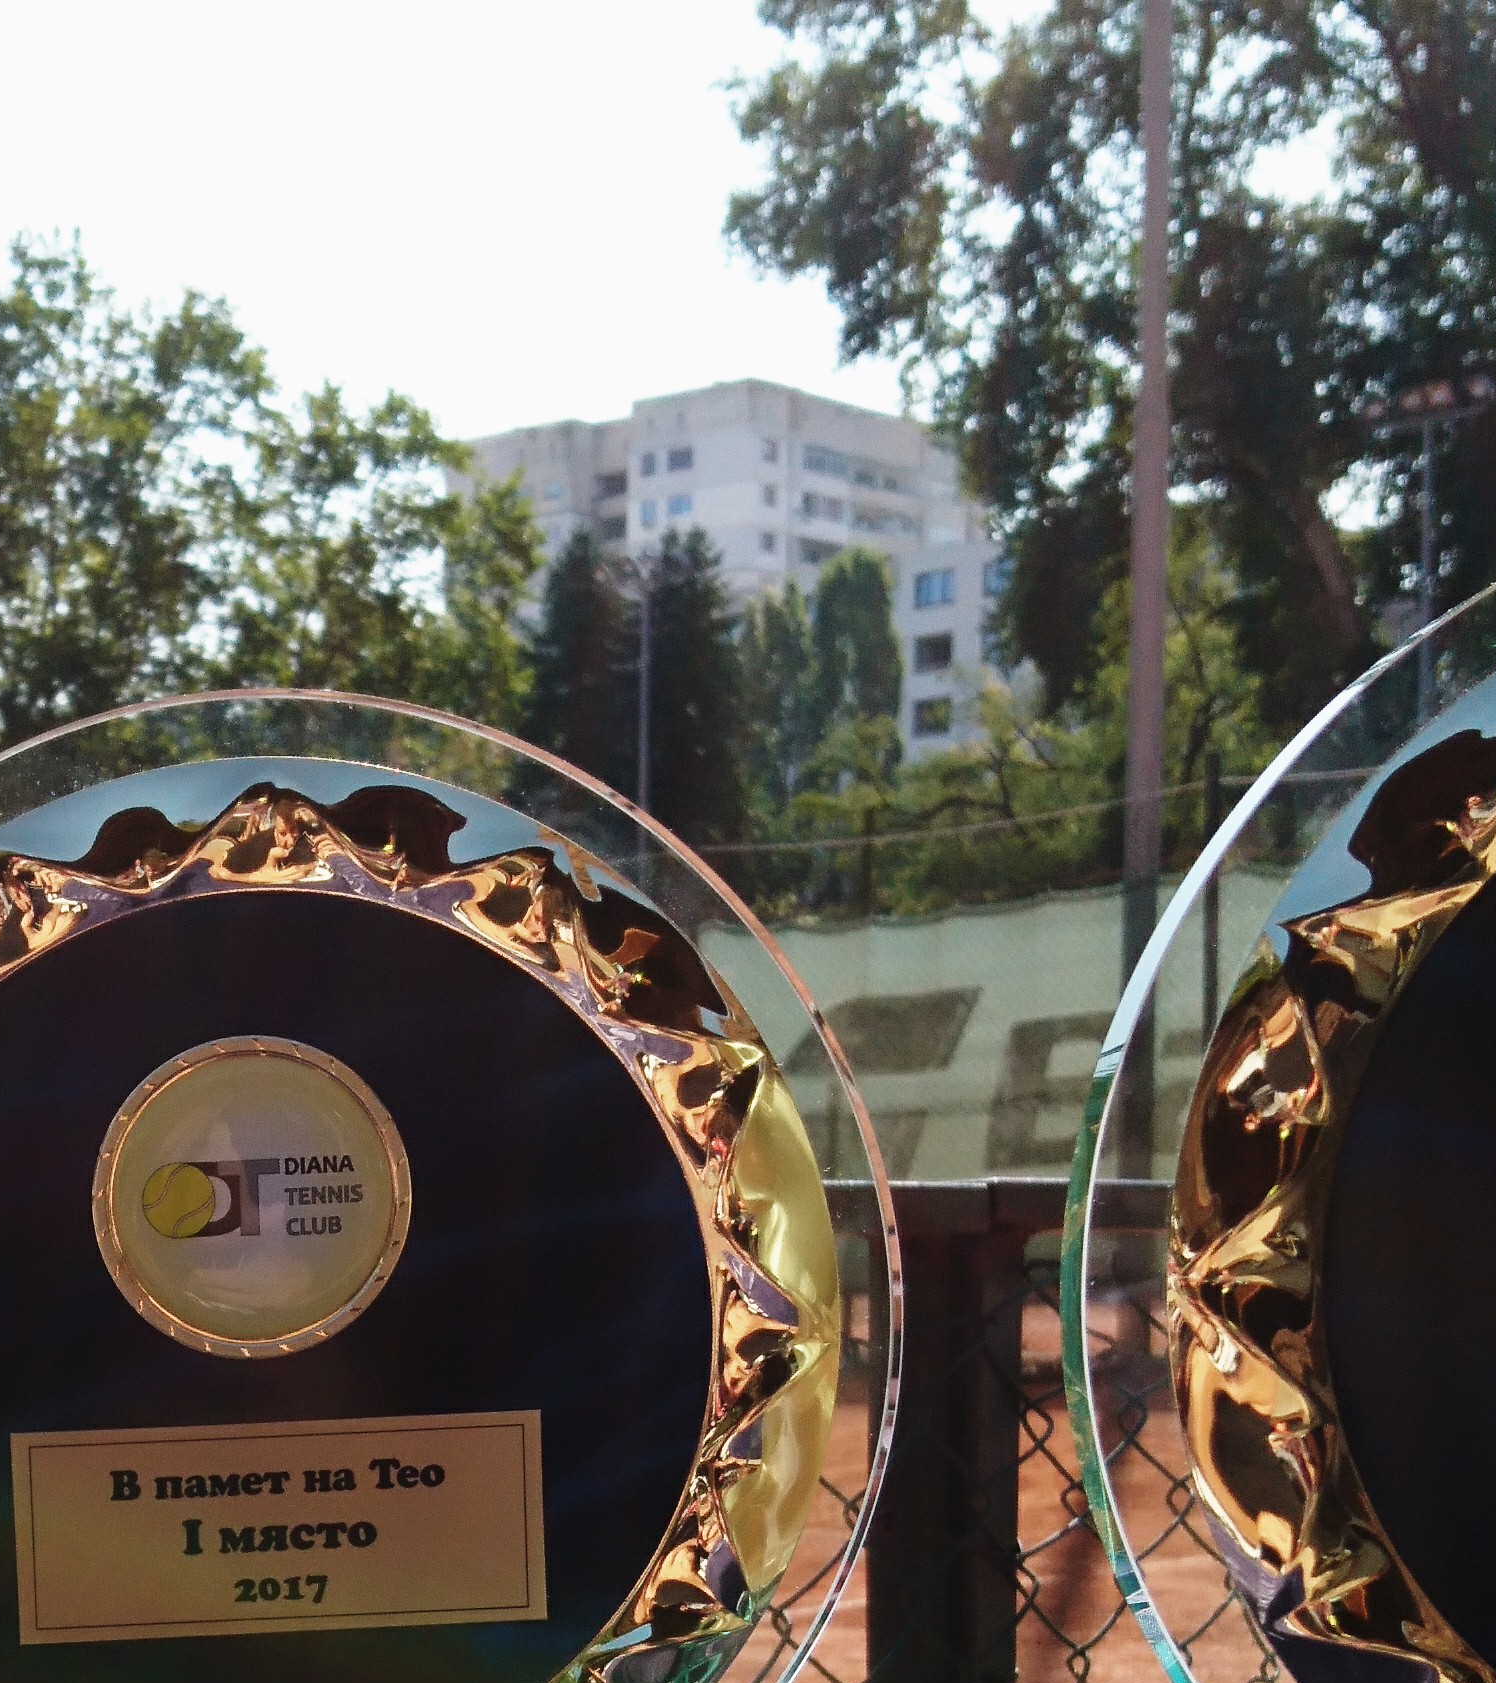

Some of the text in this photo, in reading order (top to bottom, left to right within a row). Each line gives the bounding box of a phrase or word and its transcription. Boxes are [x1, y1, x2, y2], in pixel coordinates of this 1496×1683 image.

[285, 1156, 354, 1175] DIANA
[285, 1185, 363, 1205] TENNIS
[286, 1216, 342, 1236] CLUB
[110, 1458, 445, 1500] В памет на Тео
[219, 1522, 377, 1553] място
[235, 1575, 327, 1603] 2017
